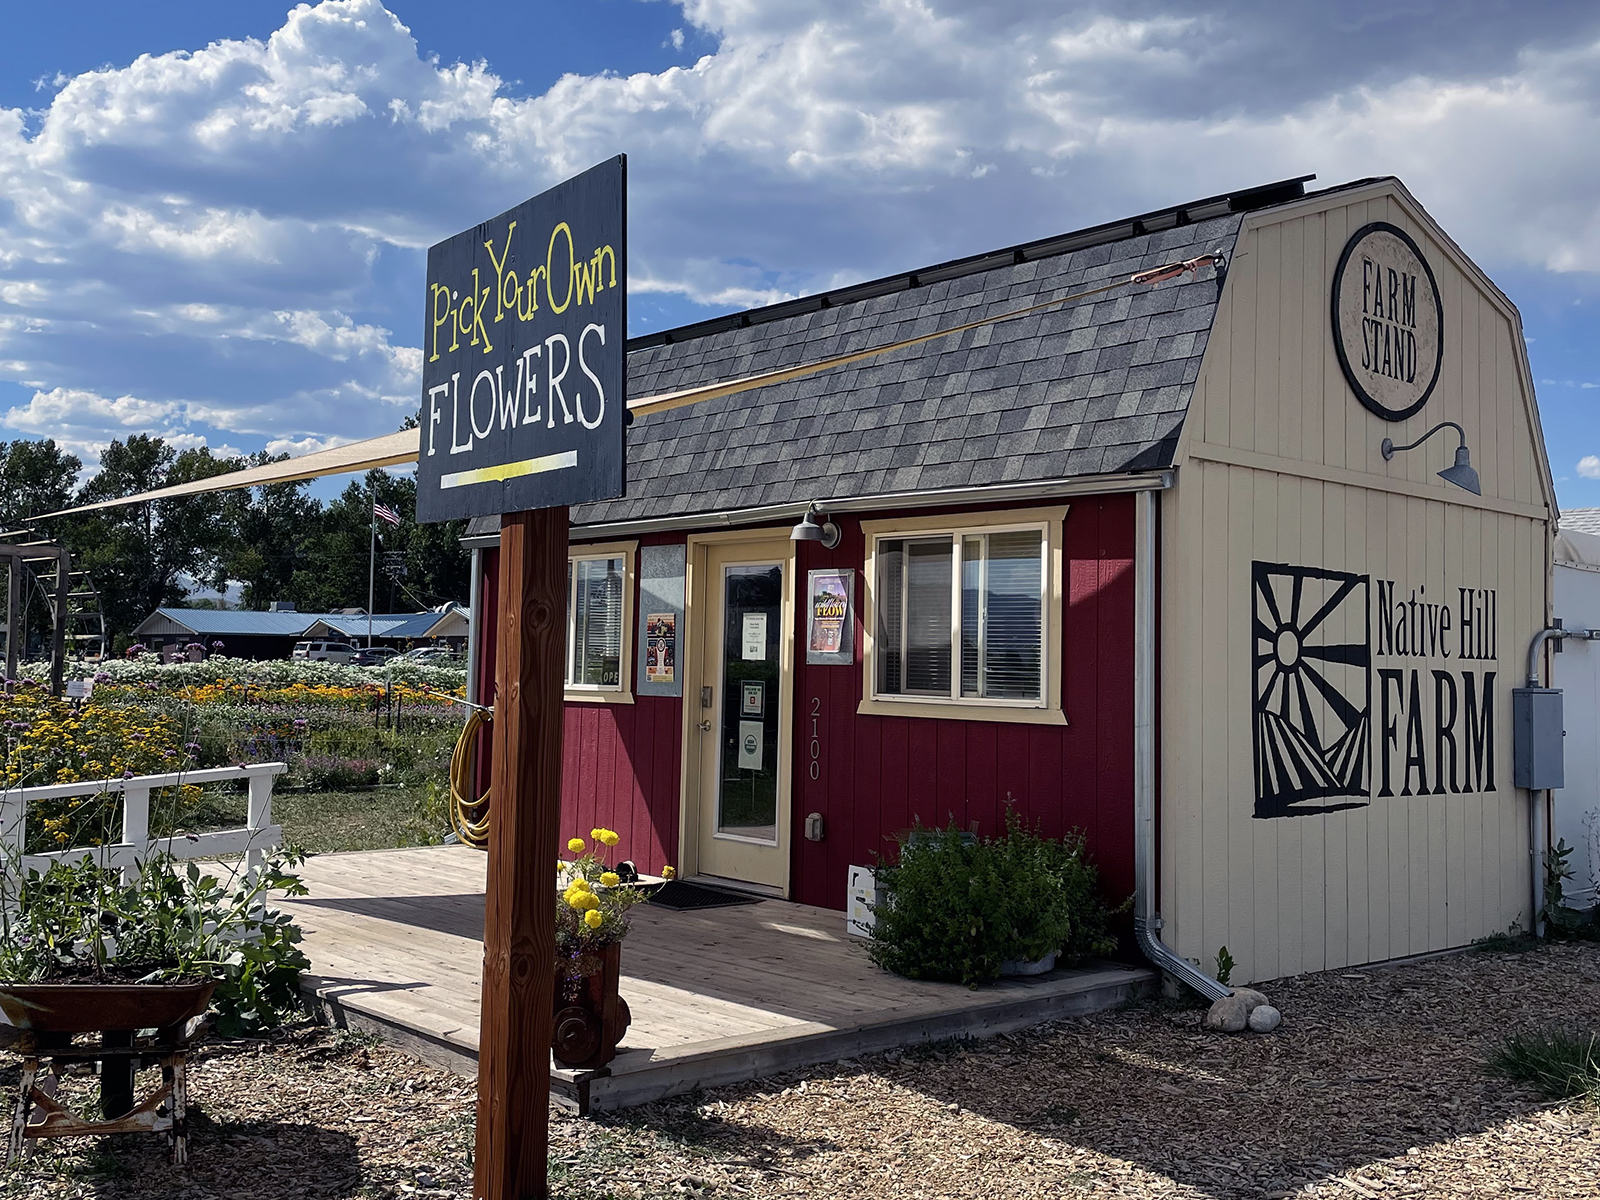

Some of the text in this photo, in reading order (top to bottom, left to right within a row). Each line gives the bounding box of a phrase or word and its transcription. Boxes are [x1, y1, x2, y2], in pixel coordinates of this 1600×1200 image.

[429, 220, 617, 362] Pick Your Own
[1363, 256, 1416, 329] FARM
[427, 323, 605, 456] FLOWERS
[1362, 315, 1416, 383] STAND
[817, 605, 843, 617] FLOW
[1377, 579, 1497, 660] Native Hill
[603, 671, 619, 683] OPE
[810, 697, 820, 780] 2100
[1377, 668, 1497, 798] FARM
